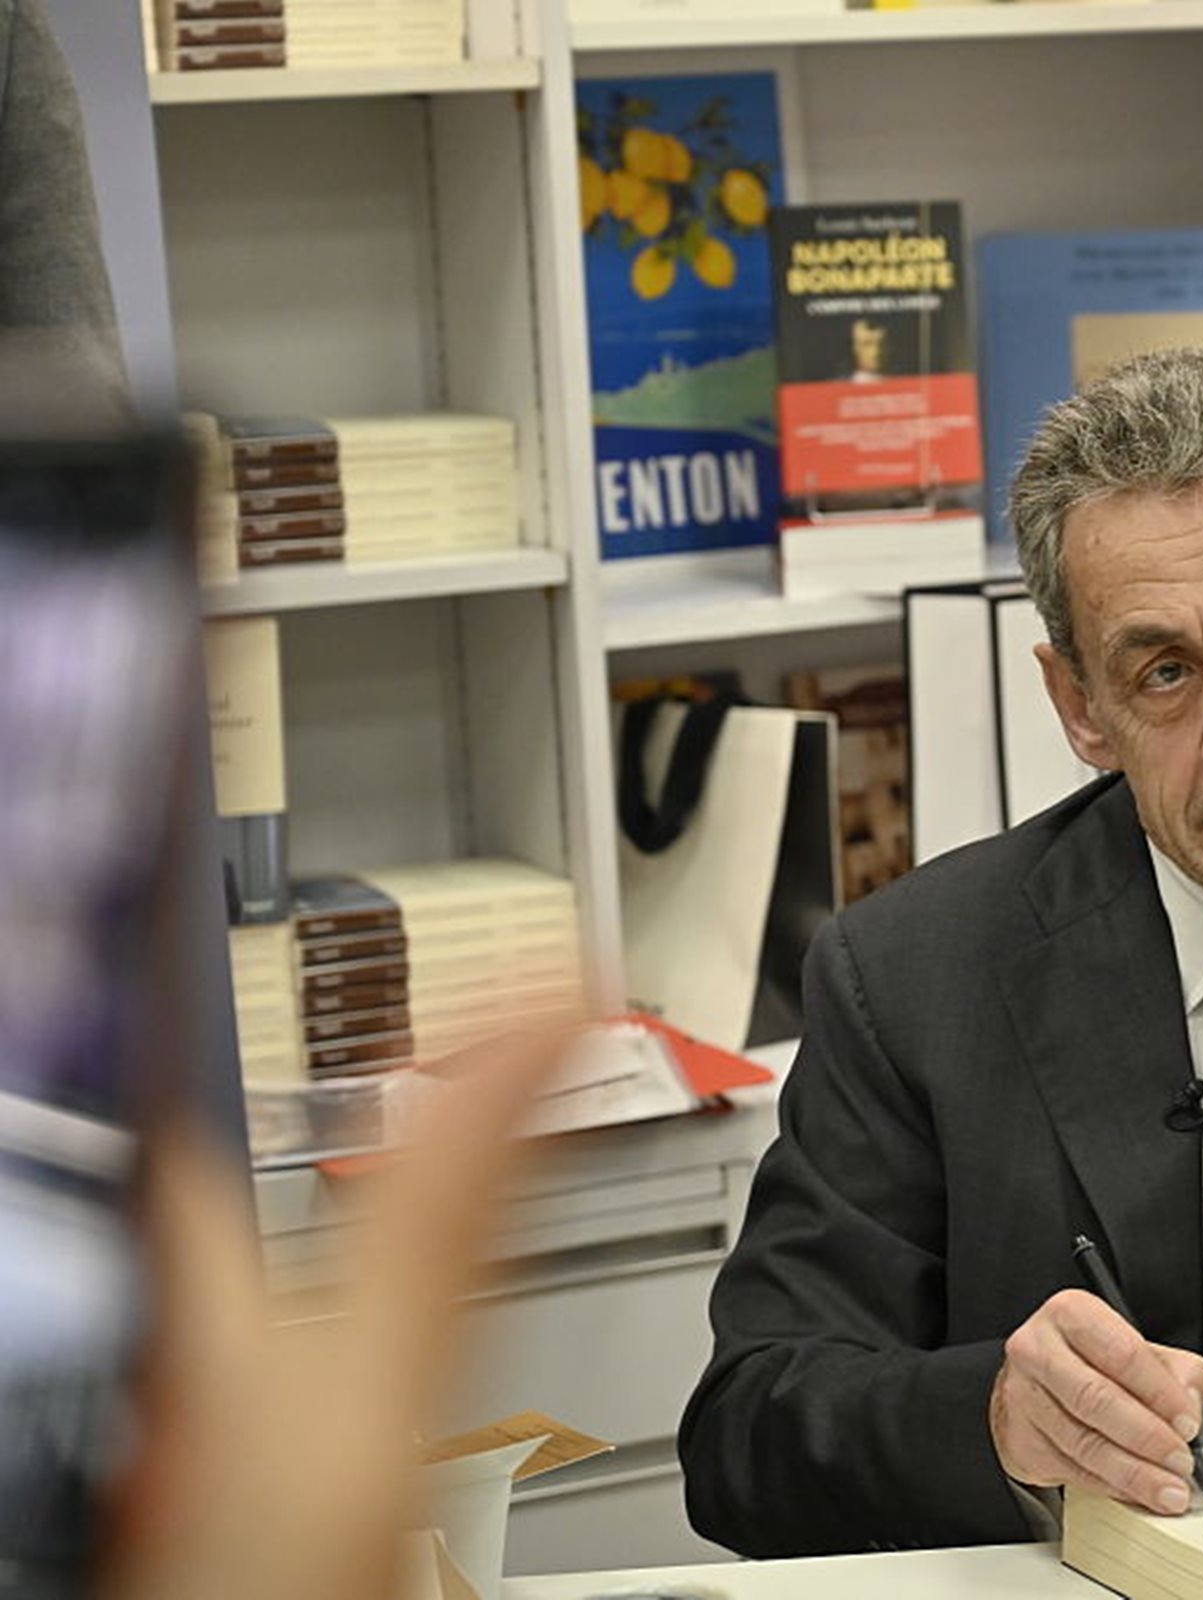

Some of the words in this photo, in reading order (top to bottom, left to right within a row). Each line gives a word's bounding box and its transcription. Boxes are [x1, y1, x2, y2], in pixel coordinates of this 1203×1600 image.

[791, 231, 946, 264] NAPOLÉON
[786, 261, 954, 295] BONAPARTE
[598, 449, 760, 534] ENTON
